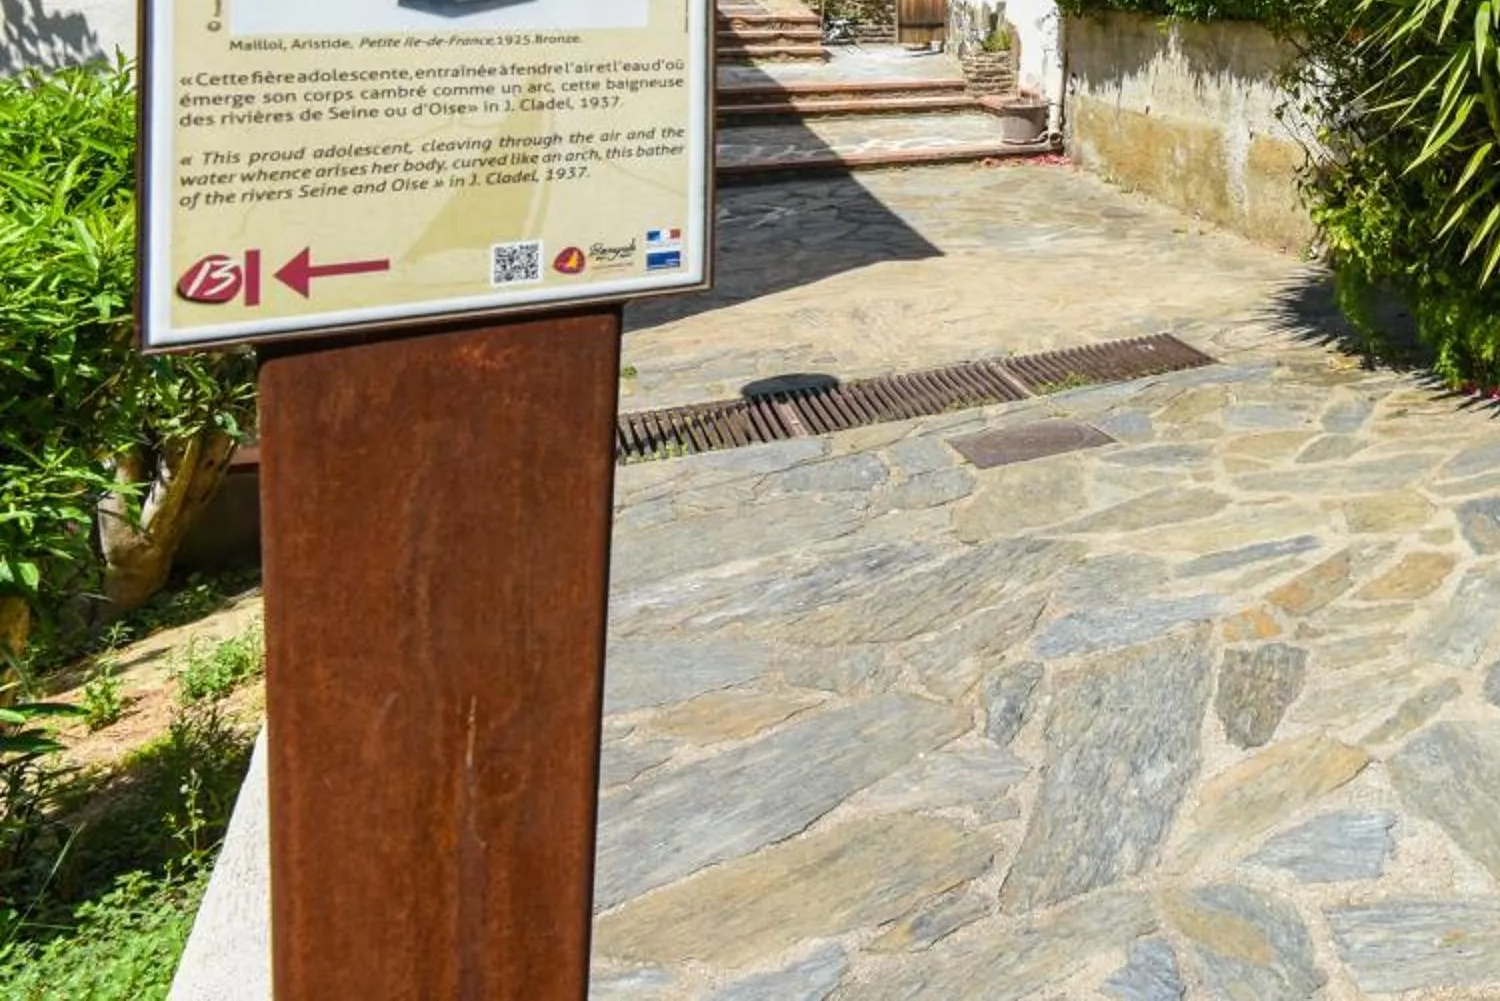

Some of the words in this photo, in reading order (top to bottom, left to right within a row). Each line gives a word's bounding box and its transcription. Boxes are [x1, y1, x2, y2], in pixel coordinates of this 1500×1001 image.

[179, 92, 256, 109] émerge
[262, 91, 297, 104] son
[303, 88, 354, 103] corps
[360, 85, 427, 99] cambré
[433, 84, 495, 97] comme
[501, 83, 523, 96] un
[560, 78, 601, 92] cette
[605, 76, 685, 92] baigneuse
[195, 72, 249, 86] Cette
[250, 70, 296, 84] fière
[296, 67, 414, 83] adolescente,
[415, 64, 497, 80] entraînée
[510, 63, 564, 76] fendre
[179, 113, 216, 127] des
[220, 110, 294, 125] rivières
[299, 108, 324, 122] de
[328, 105, 379, 120] Seine
[384, 106, 407, 118] ou
[483, 100, 499, 112] in
[202, 150, 241, 166] This
[247, 146, 307, 167] proud
[421, 137, 493, 153] cleaving
[499, 132, 563, 149] through
[568, 130, 595, 144] the
[599, 129, 622, 143] air
[626, 126, 657, 141] and
[660, 125, 685, 139] the
[179, 172, 237, 187] water
[240, 167, 313, 183] whence
[315, 162, 369, 179] arises
[371, 161, 403, 175] her
[451, 152, 508, 170] curved
[510, 152, 540, 166] like
[541, 151, 563, 165] an
[564, 148, 603, 163] arch,
[605, 146, 635, 160] this
[636, 143, 686, 158] bather
[179, 191, 201, 211] of
[204, 189, 237, 206] the
[241, 187, 293, 203] rivers
[297, 183, 350, 199] Seine
[352, 179, 388, 195] and
[391, 177, 430, 193] Oise
[449, 174, 466, 189] in
[185, 257, 238, 298] 13
